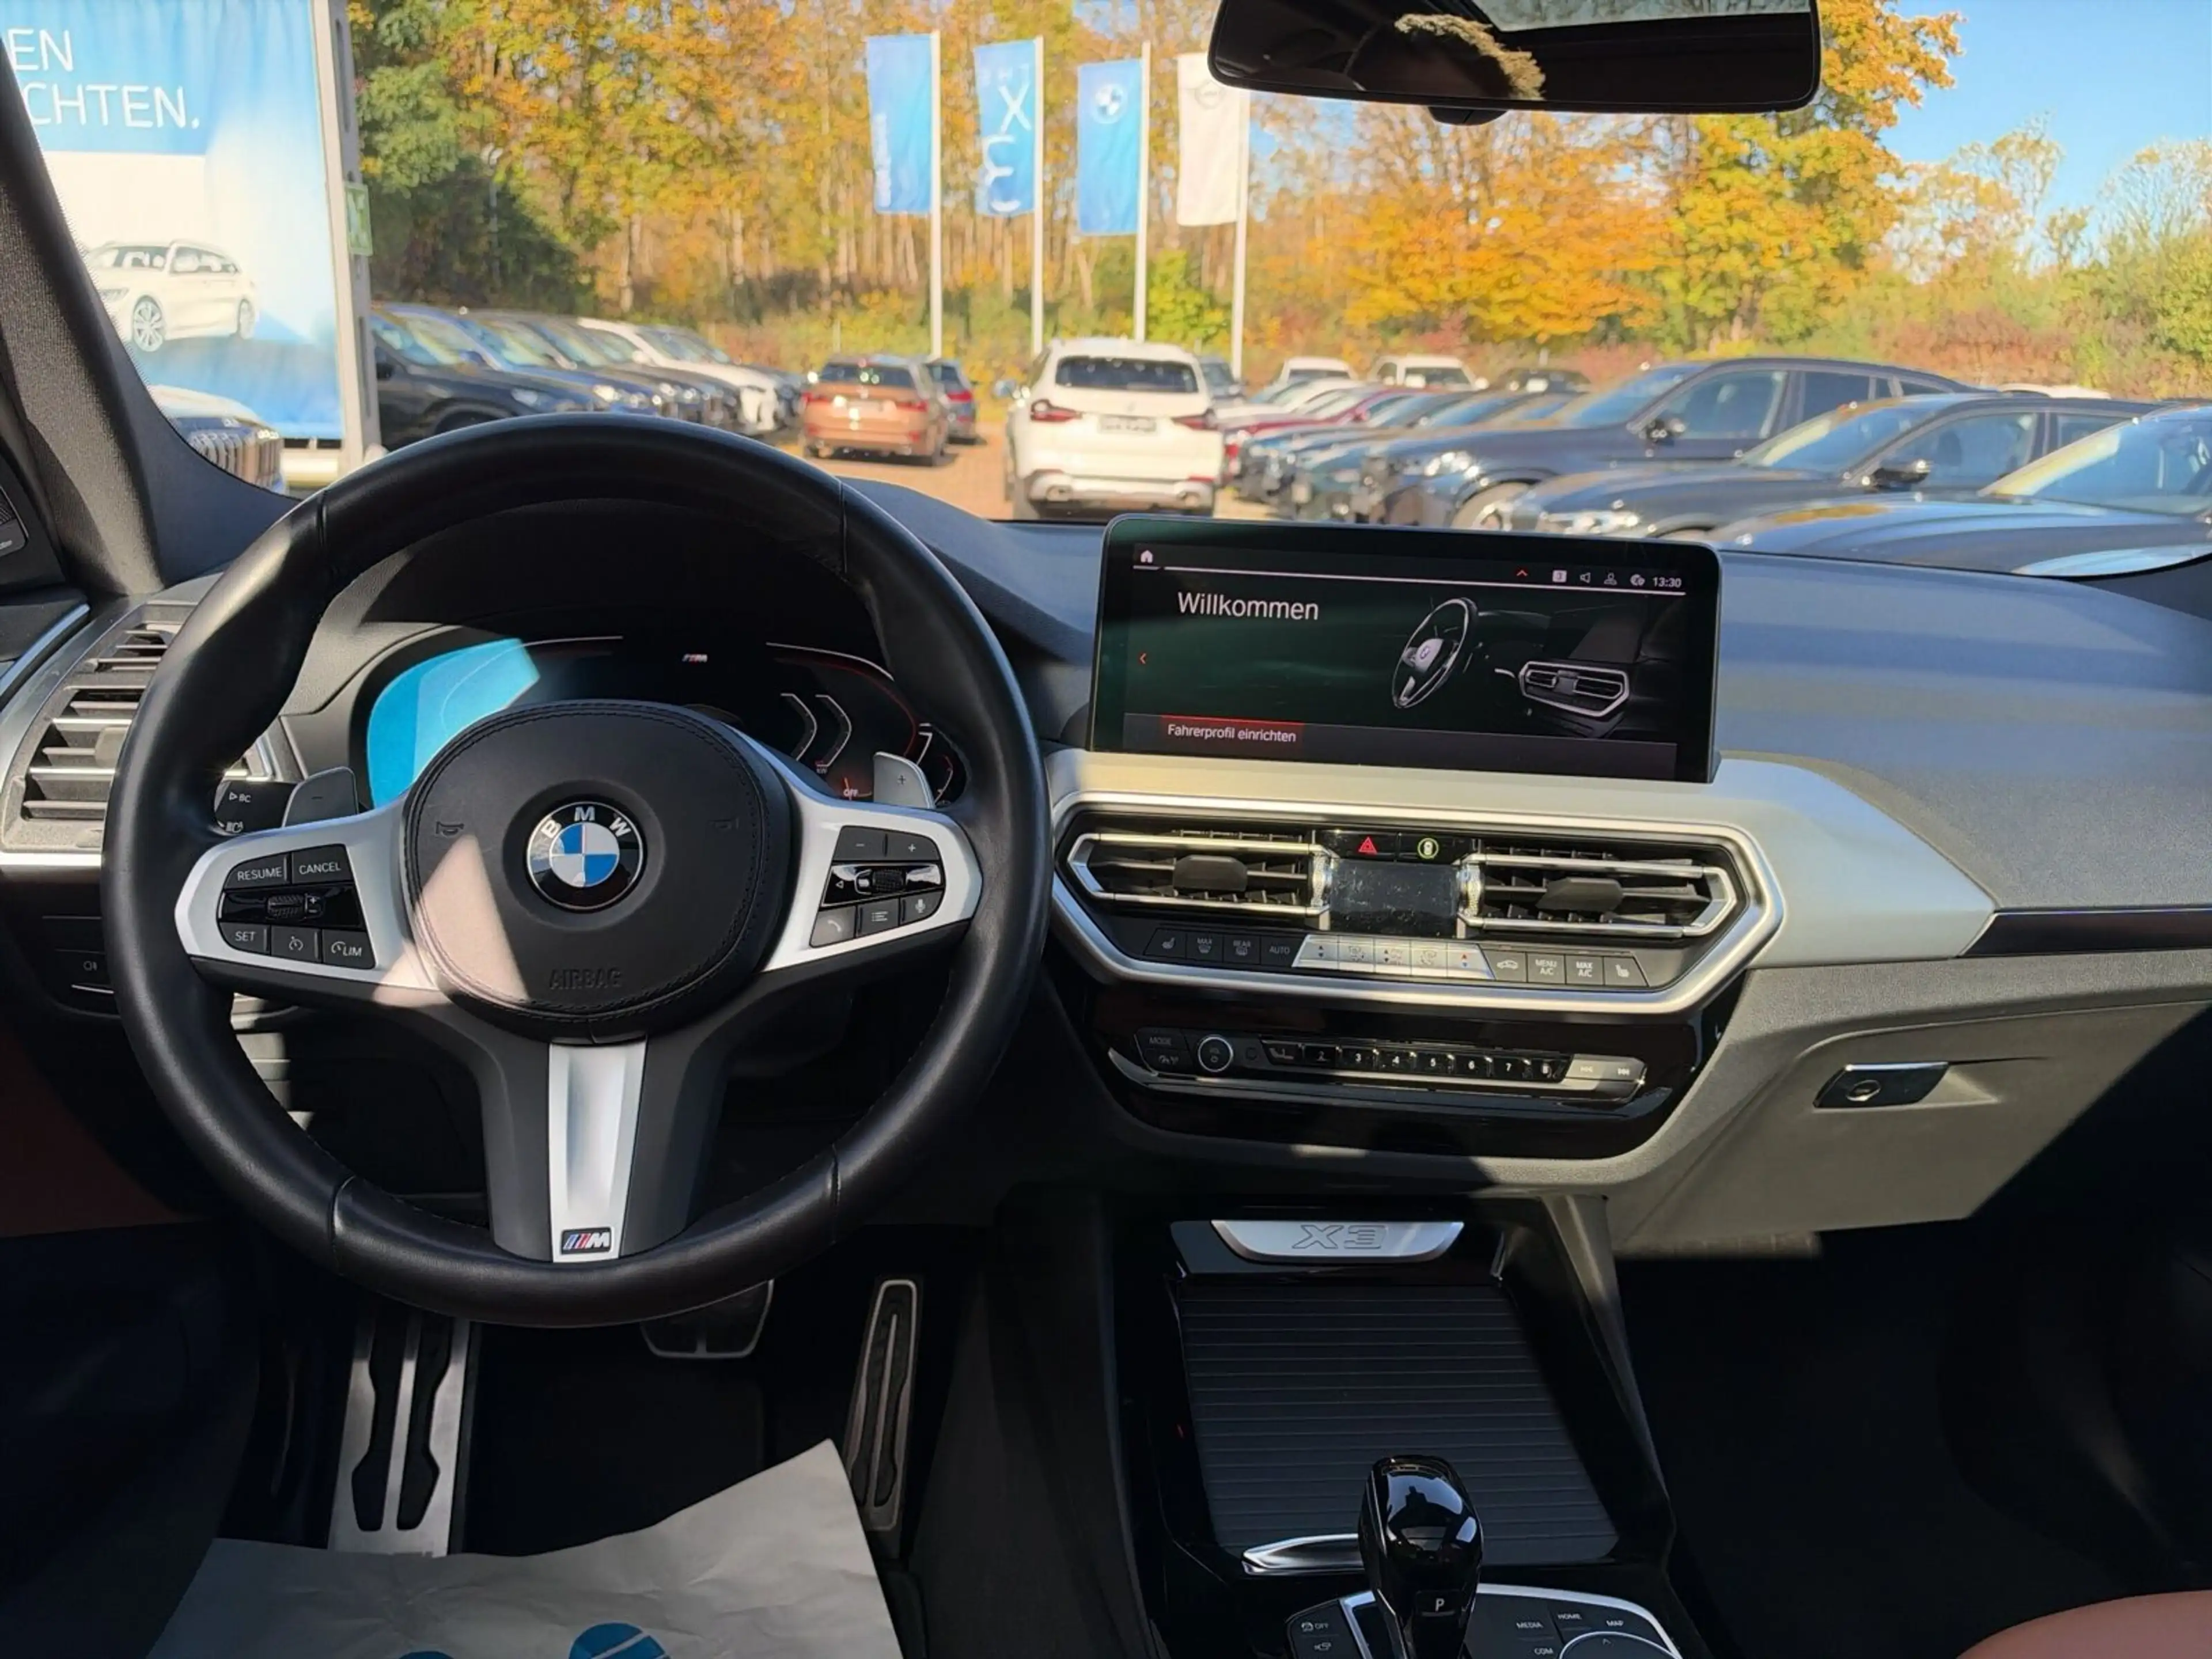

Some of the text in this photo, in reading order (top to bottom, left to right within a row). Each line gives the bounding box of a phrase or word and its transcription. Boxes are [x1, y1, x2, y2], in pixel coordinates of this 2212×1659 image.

[1652, 576, 1683, 588] 13:30
[1176, 591, 1320, 622] Willkommen
[1167, 723, 1297, 745] Fahrerprofil einrichten
[237, 866, 283, 881] RESUME
[298, 862, 342, 875] CANCEL
[234, 930, 255, 942] SET
[342, 946, 362, 957] LIM
[1268, 945, 1291, 955] AUTO
[1535, 959, 1558, 968] MENU
[1575, 961, 1593, 969] MAX
[1540, 968, 1554, 976] A/C
[1578, 969, 1593, 978] A/C
[549, 968, 622, 990] AIRBAG
[1355, 1053, 1362, 1062] 3
[1392, 1055, 1400, 1065] 4
[1430, 1058, 1436, 1067] 5
[1468, 1060, 1475, 1070] 6
[1505, 1062, 1512, 1072] 7
[1291, 1225, 1388, 1249] X3
[1434, 1597, 1445, 1612] P
[1516, 1620, 1543, 1629] MEDIA
[1605, 1619, 1624, 1627] MAP
[1533, 1647, 1554, 1656] COM
